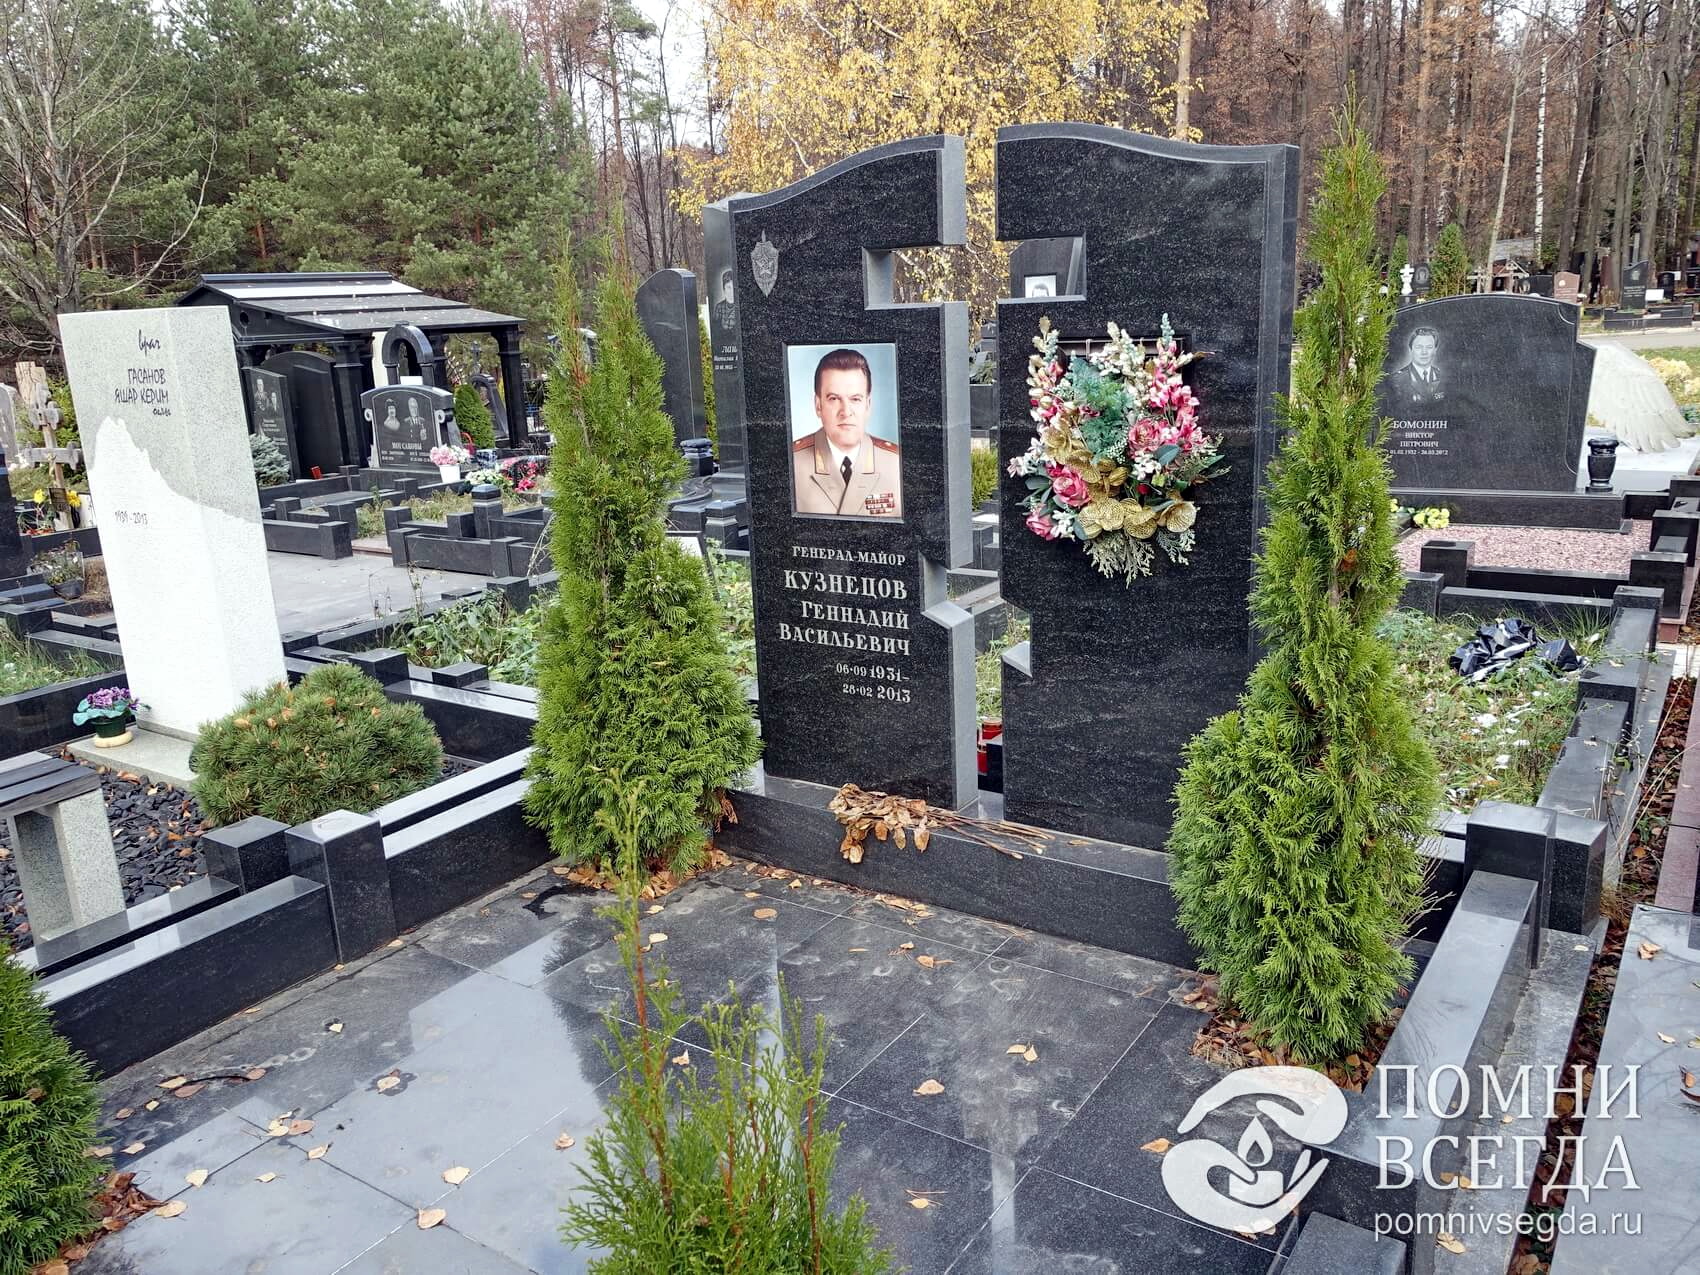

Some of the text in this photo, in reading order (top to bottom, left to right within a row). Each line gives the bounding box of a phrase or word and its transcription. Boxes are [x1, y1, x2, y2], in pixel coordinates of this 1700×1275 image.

[127, 367, 166, 385] ГАСАНОВ
[114, 387, 169, 405] ЯШАР КЕРИМ
[1393, 420, 1448, 429] БОМОНИН
[792, 545, 906, 566] ГЕНЕРАЛ-МАЙОР
[783, 569, 908, 600] КУЗНЕЦОВ
[801, 600, 910, 630] ГЕННАДИЙ
[779, 622, 910, 656] ВАСИЛЬЕВИЧ
[876, 685, 911, 704] 2013
